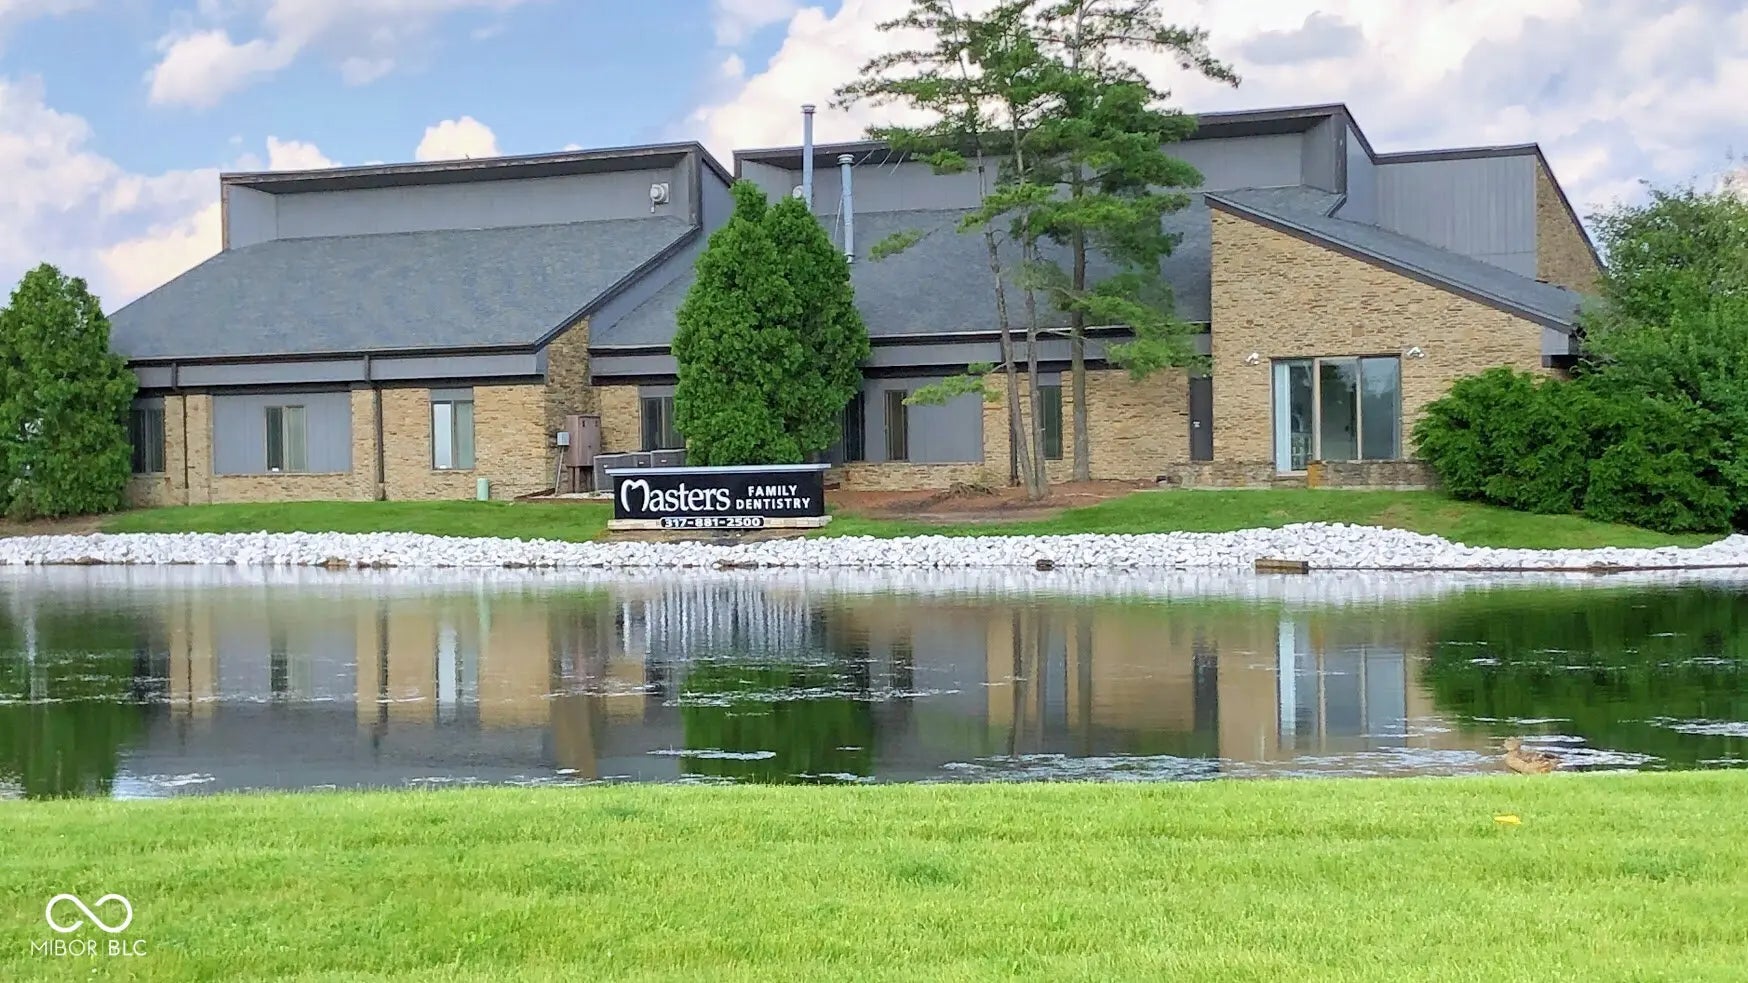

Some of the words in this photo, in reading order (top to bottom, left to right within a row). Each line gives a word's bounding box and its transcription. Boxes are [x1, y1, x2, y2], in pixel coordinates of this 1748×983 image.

[621, 479, 730, 512] Masters
[748, 485, 797, 497] FAMILY
[736, 497, 811, 510] DENTISTRY
[664, 517, 762, 527] 317-881-2500
